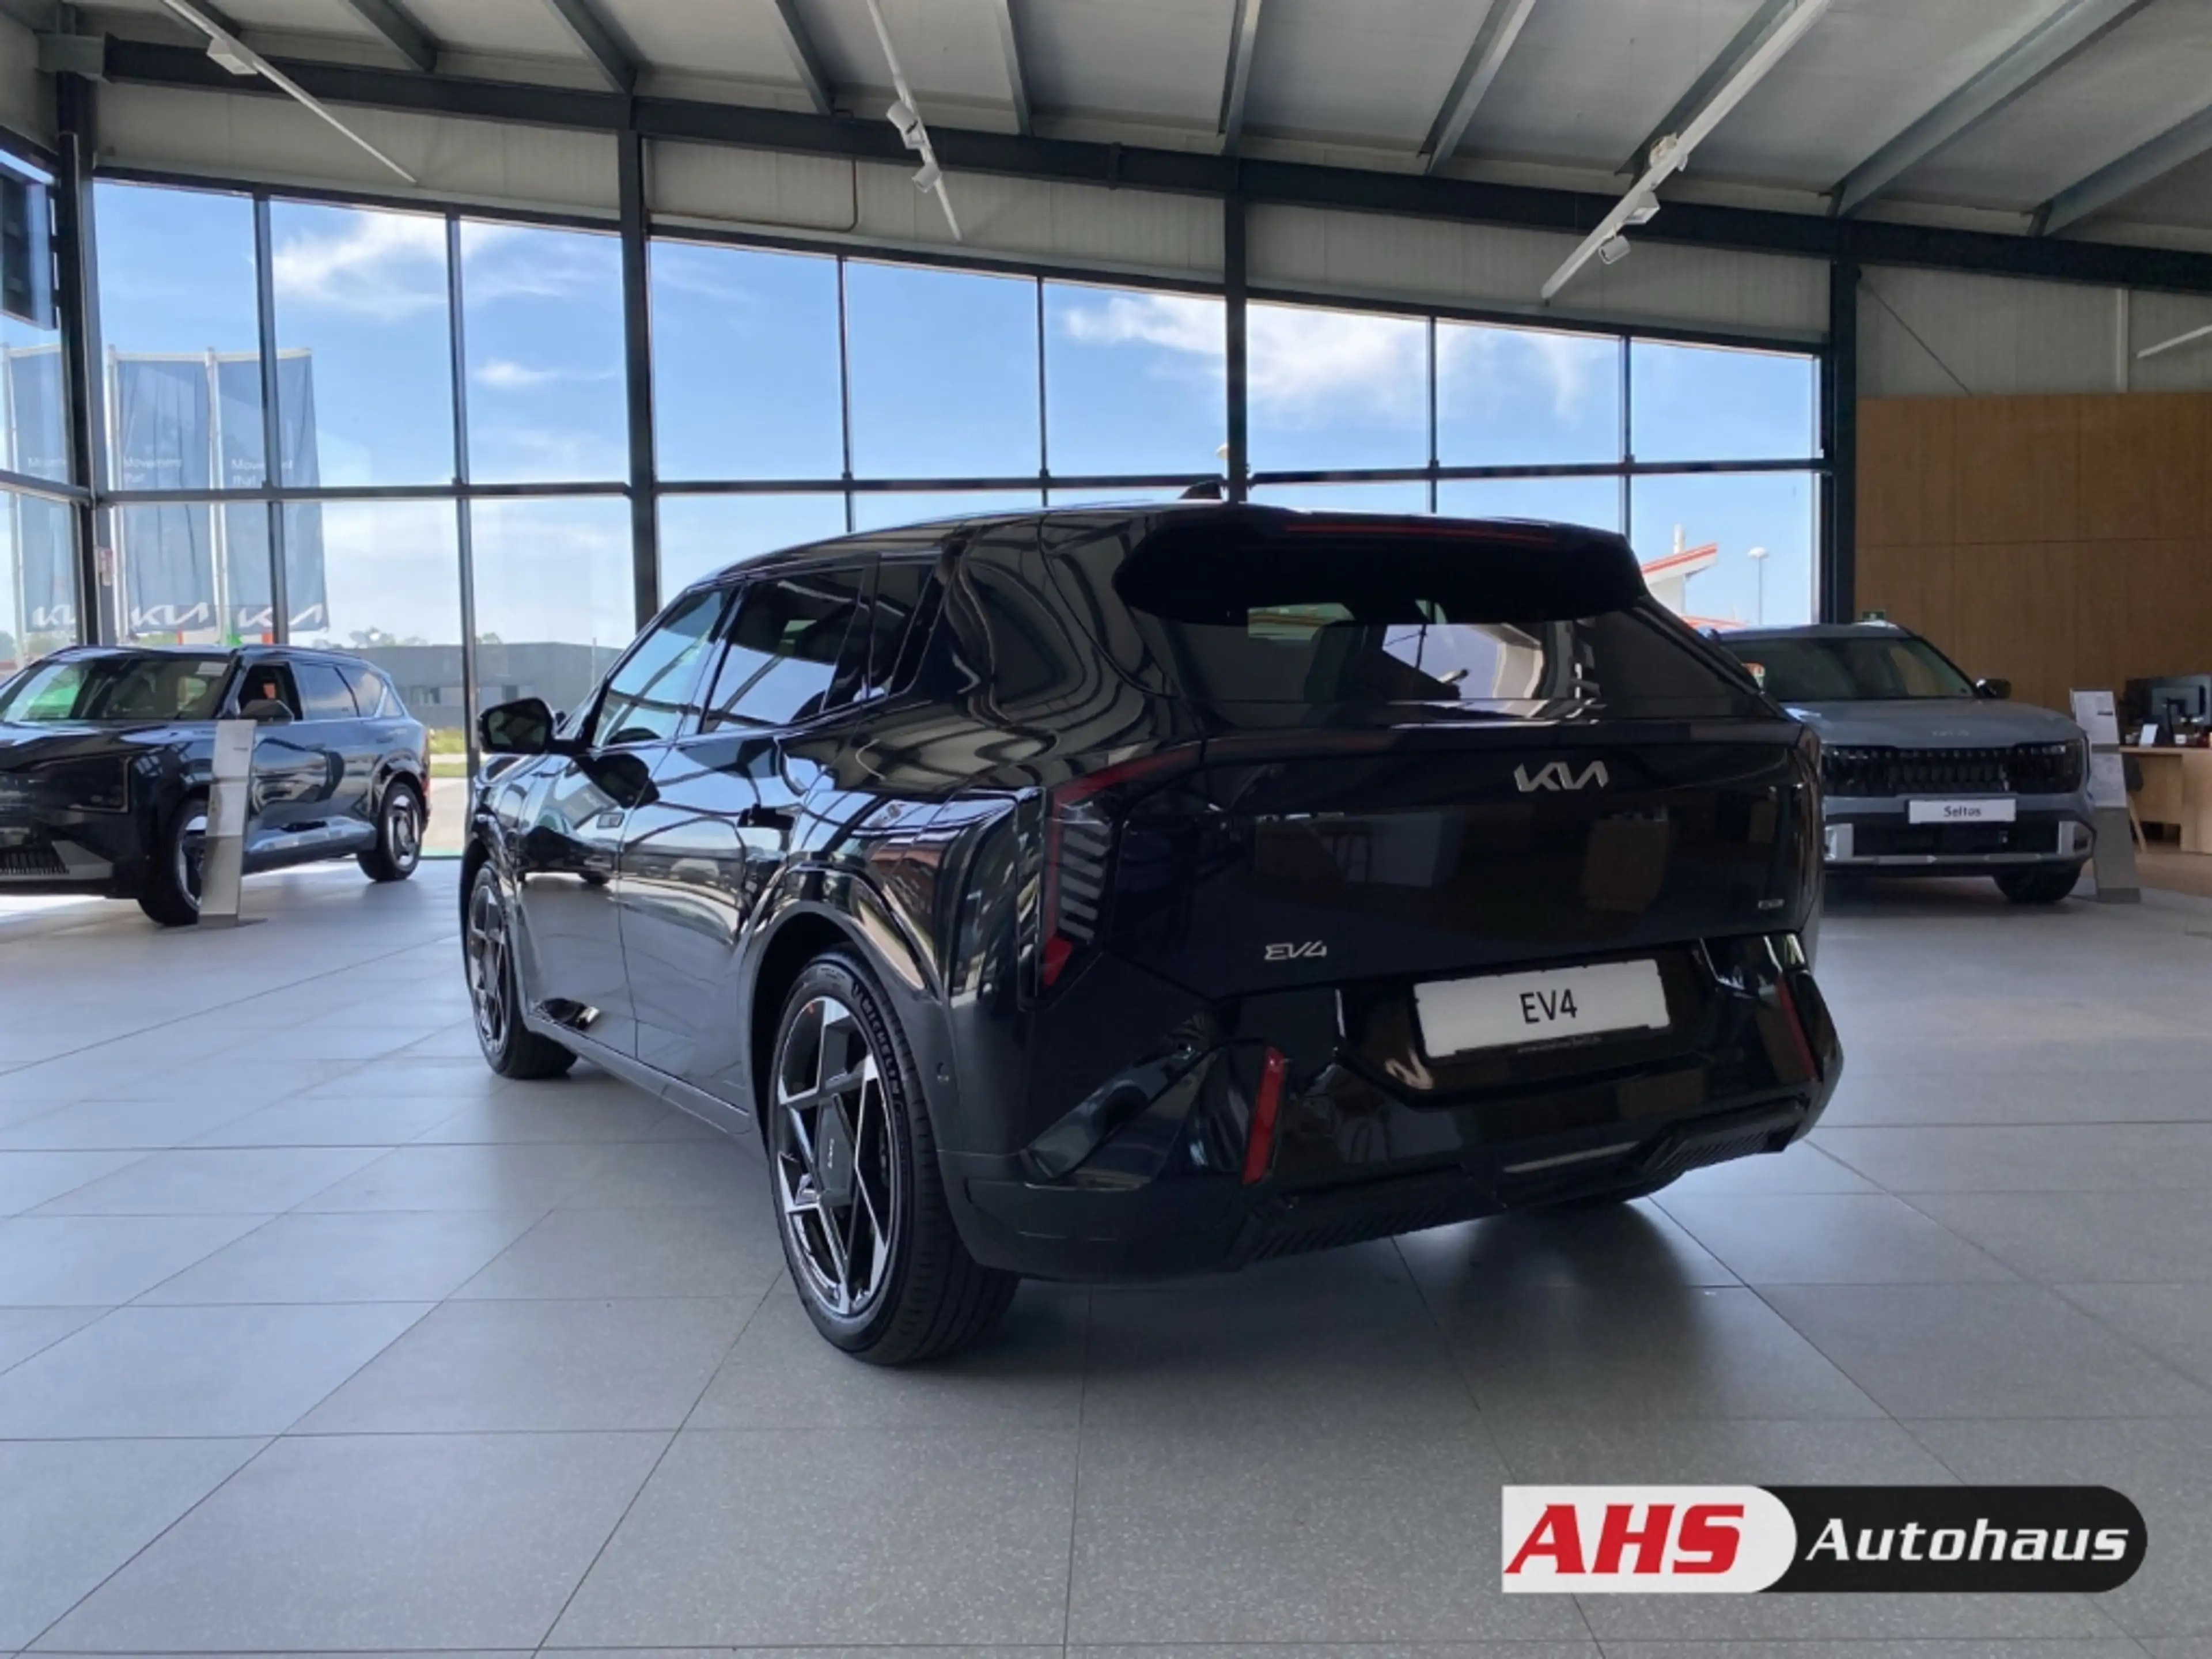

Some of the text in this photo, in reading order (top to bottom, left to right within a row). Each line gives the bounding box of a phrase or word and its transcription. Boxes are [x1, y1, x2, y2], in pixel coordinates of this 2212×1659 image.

[131, 602, 209, 628] KIA
[238, 604, 323, 628] KA
[1513, 760, 1609, 792] KIA
[1944, 805, 1982, 817] Seltos
[1264, 940, 1328, 961] EV4
[1519, 988, 1578, 1025] EV4
[861, 998, 900, 1094] MICHELIN
